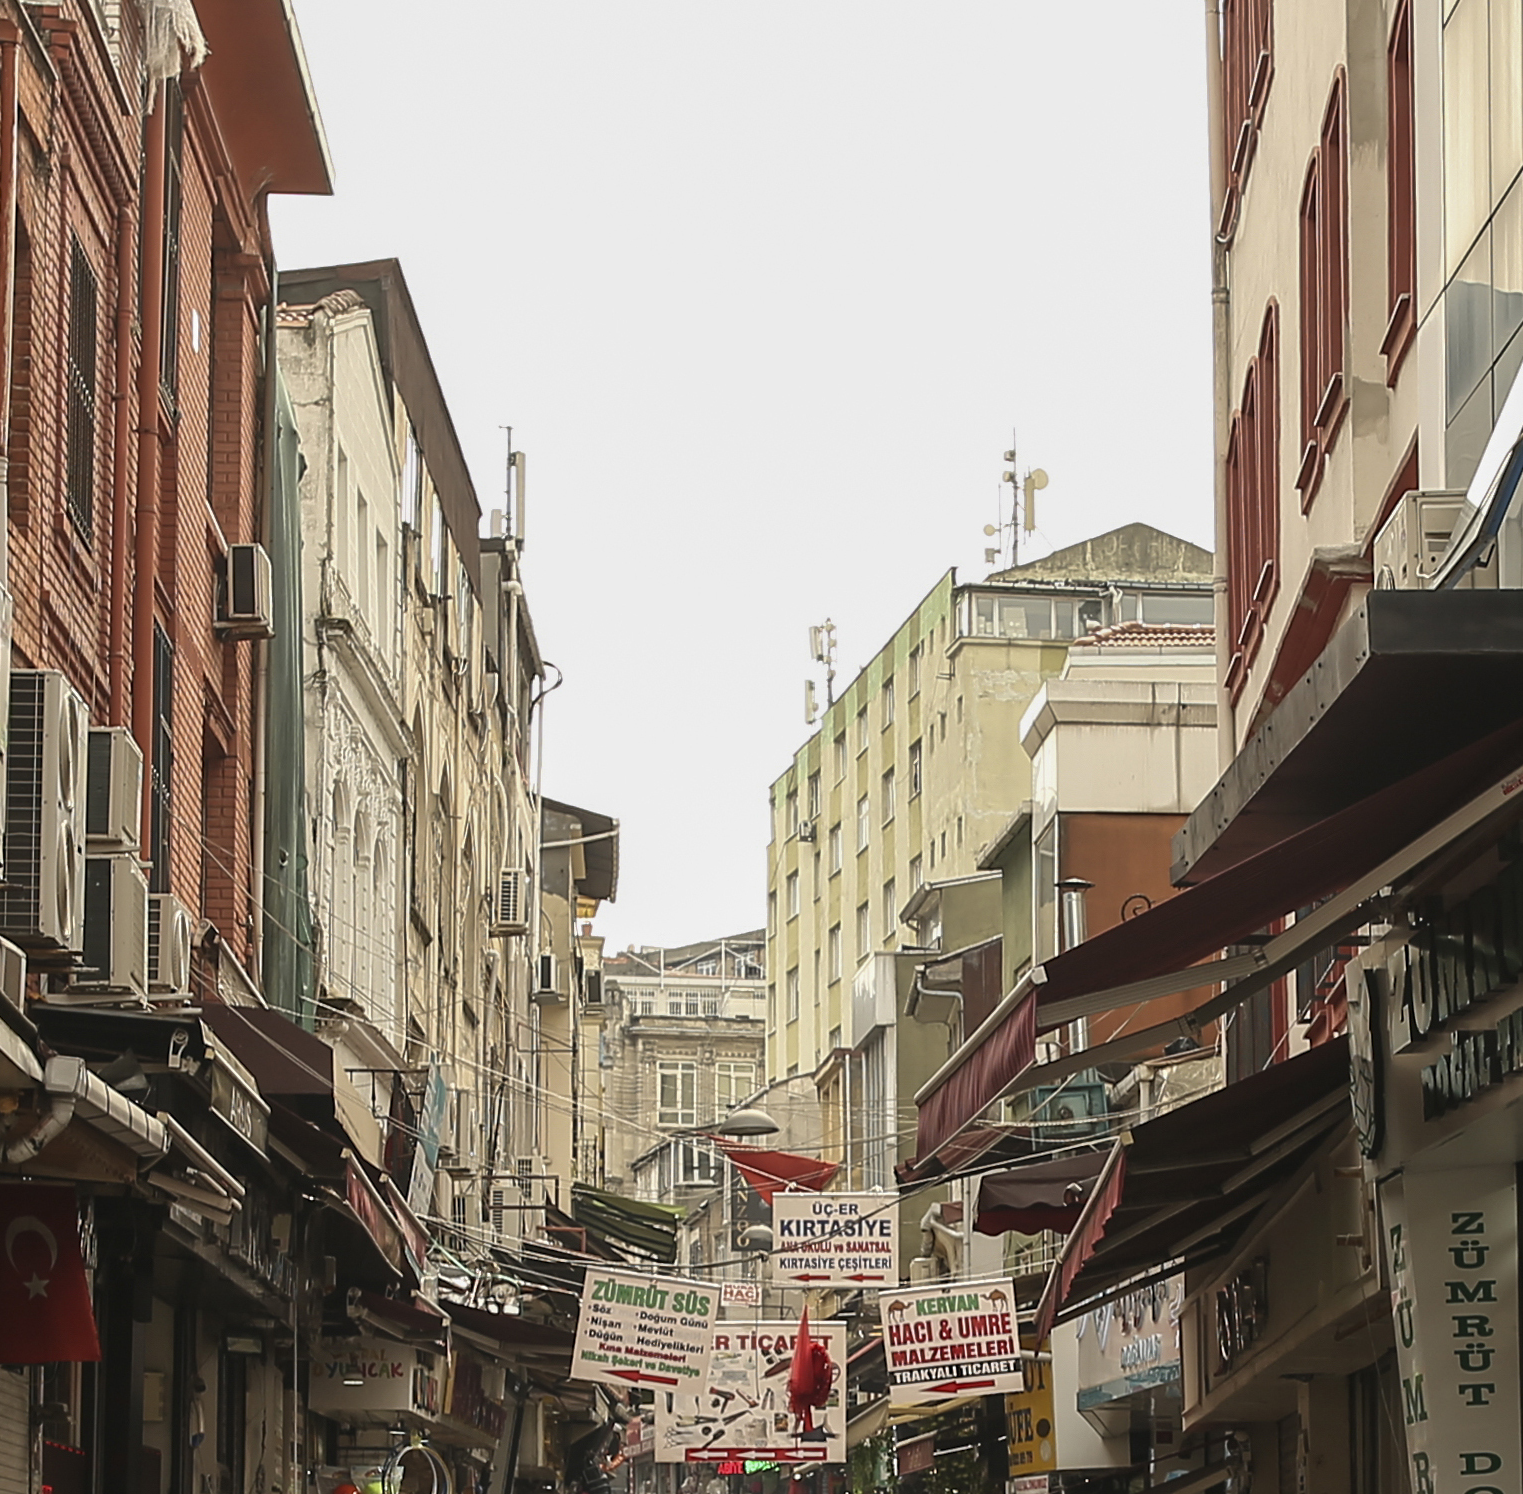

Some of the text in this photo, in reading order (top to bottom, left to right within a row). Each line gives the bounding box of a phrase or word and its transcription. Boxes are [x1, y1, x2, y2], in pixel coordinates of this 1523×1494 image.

[812, 1201, 859, 1217] ÜÇ-ER
[779, 1255, 892, 1272] KIRTASİYE ÇEŞİTLERİ
[590, 1278, 711, 1317] ZÜMRÜT SÜS
[916, 1293, 980, 1316] KERVAN
[639, 1311, 678, 1326] Doğum
[1444, 1211, 1498, 1407] ZÜMRÜT
[590, 1316, 622, 1331] Nişan
[637, 1323, 674, 1337] Mevlüt
[889, 1312, 1012, 1346] HACI & UMRE
[636, 1336, 705, 1355] Hediyelikleri
[891, 1336, 1015, 1367] MALZEMELERİ
[894, 1365, 958, 1384] TRAKYALI
